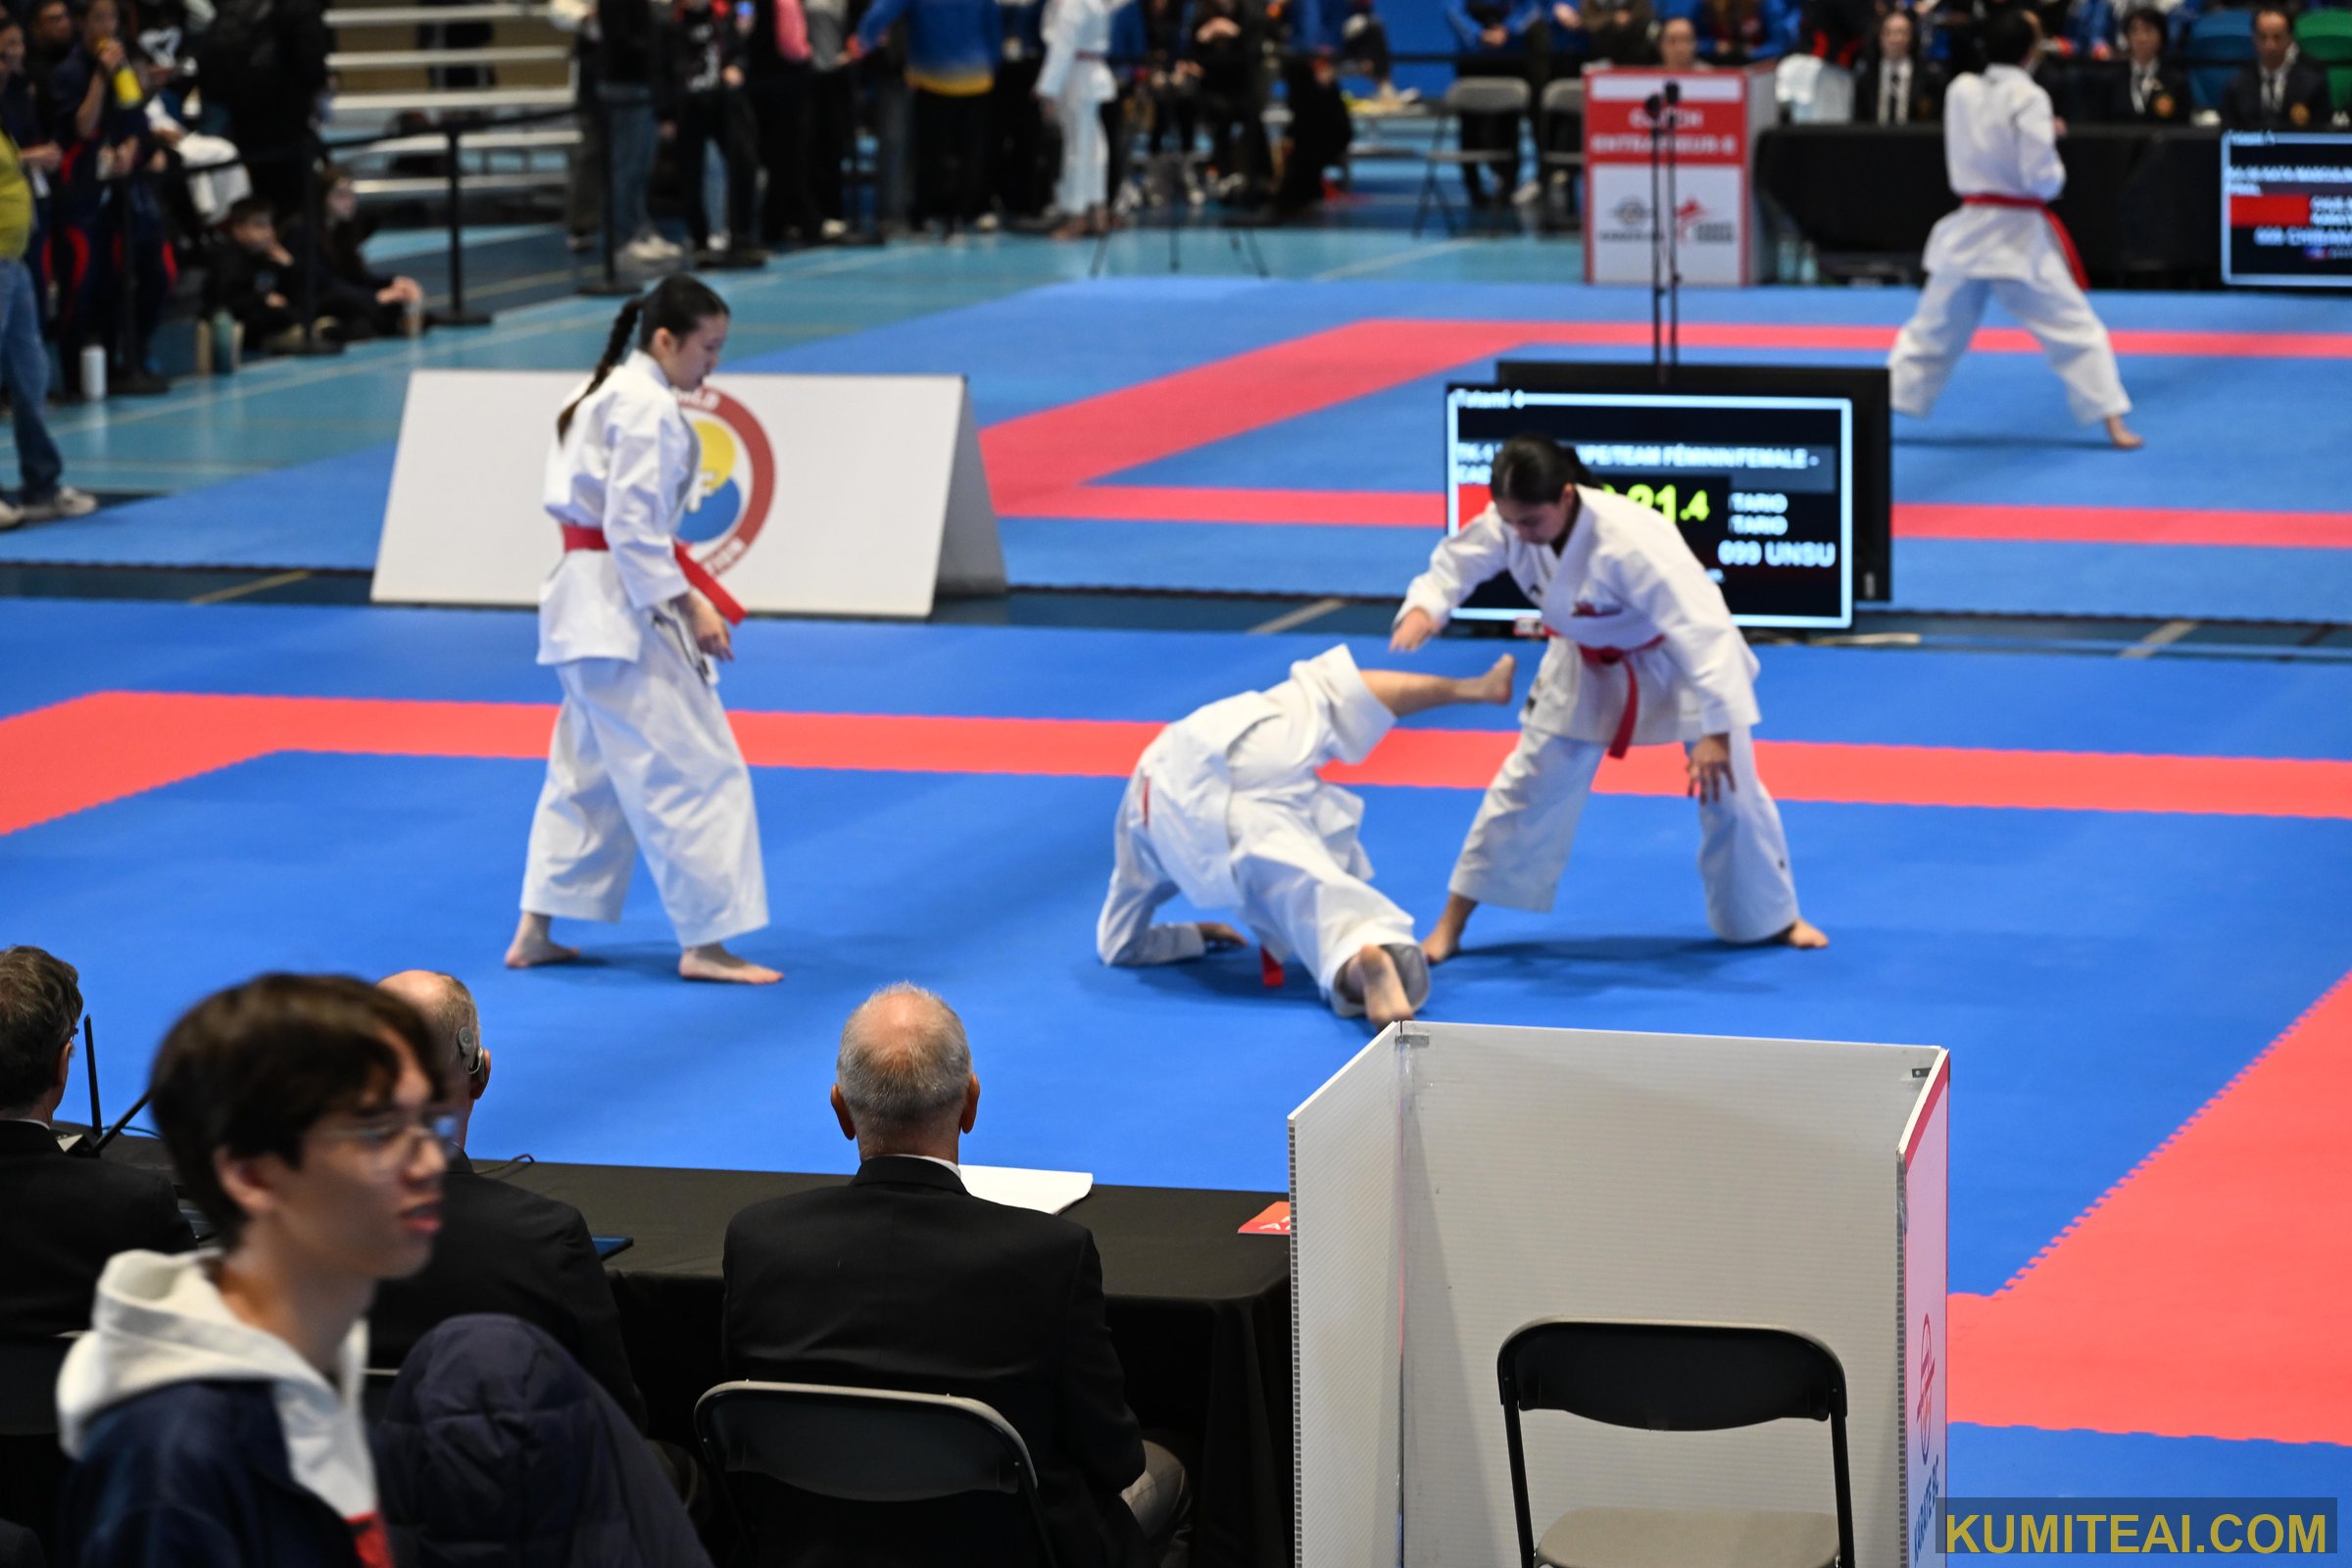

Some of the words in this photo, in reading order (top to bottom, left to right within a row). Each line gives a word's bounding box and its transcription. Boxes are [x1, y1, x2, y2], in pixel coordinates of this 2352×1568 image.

[1728, 492, 1788, 514] TARIO
[1728, 514, 1788, 536] TARIO
[1764, 540, 1836, 567] UNSU
